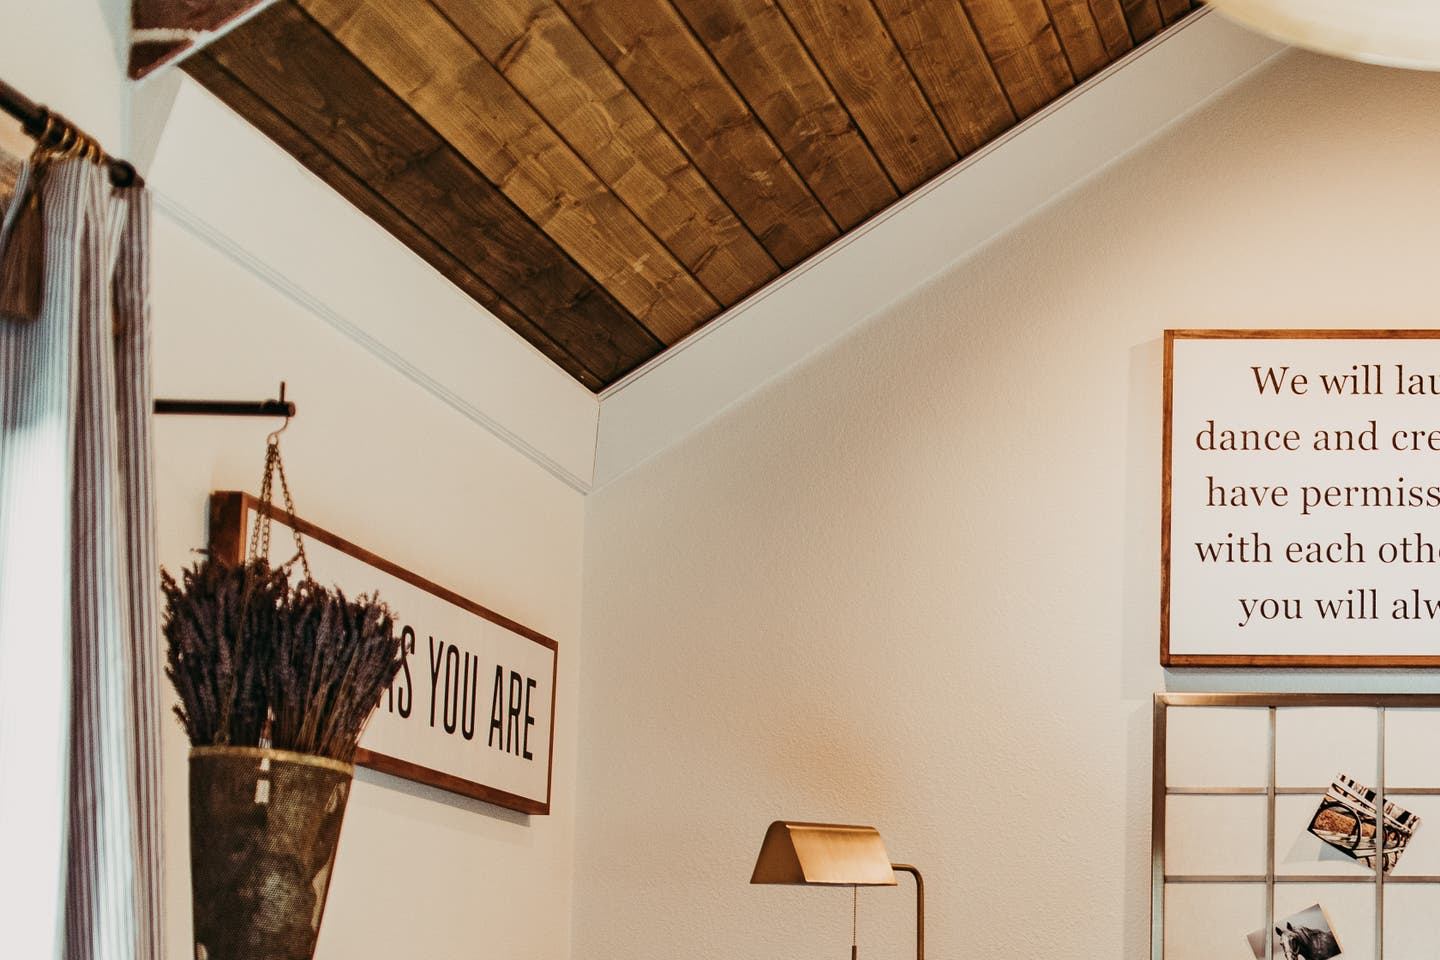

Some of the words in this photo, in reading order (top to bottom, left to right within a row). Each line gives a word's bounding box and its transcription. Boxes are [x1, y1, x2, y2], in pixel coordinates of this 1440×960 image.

[1250, 366, 1308, 396] We
[1319, 364, 1384, 395] will
[1195, 419, 1301, 451] dance
[1313, 420, 1379, 451] and
[1205, 475, 1289, 507] have
[1194, 531, 1273, 563] with
[1285, 532, 1366, 564] each
[1237, 598, 1304, 628] you
[1314, 588, 1379, 620] will
[376, 625, 416, 719] S
[429, 635, 478, 741] YOU
[488, 664, 537, 761] ARE
